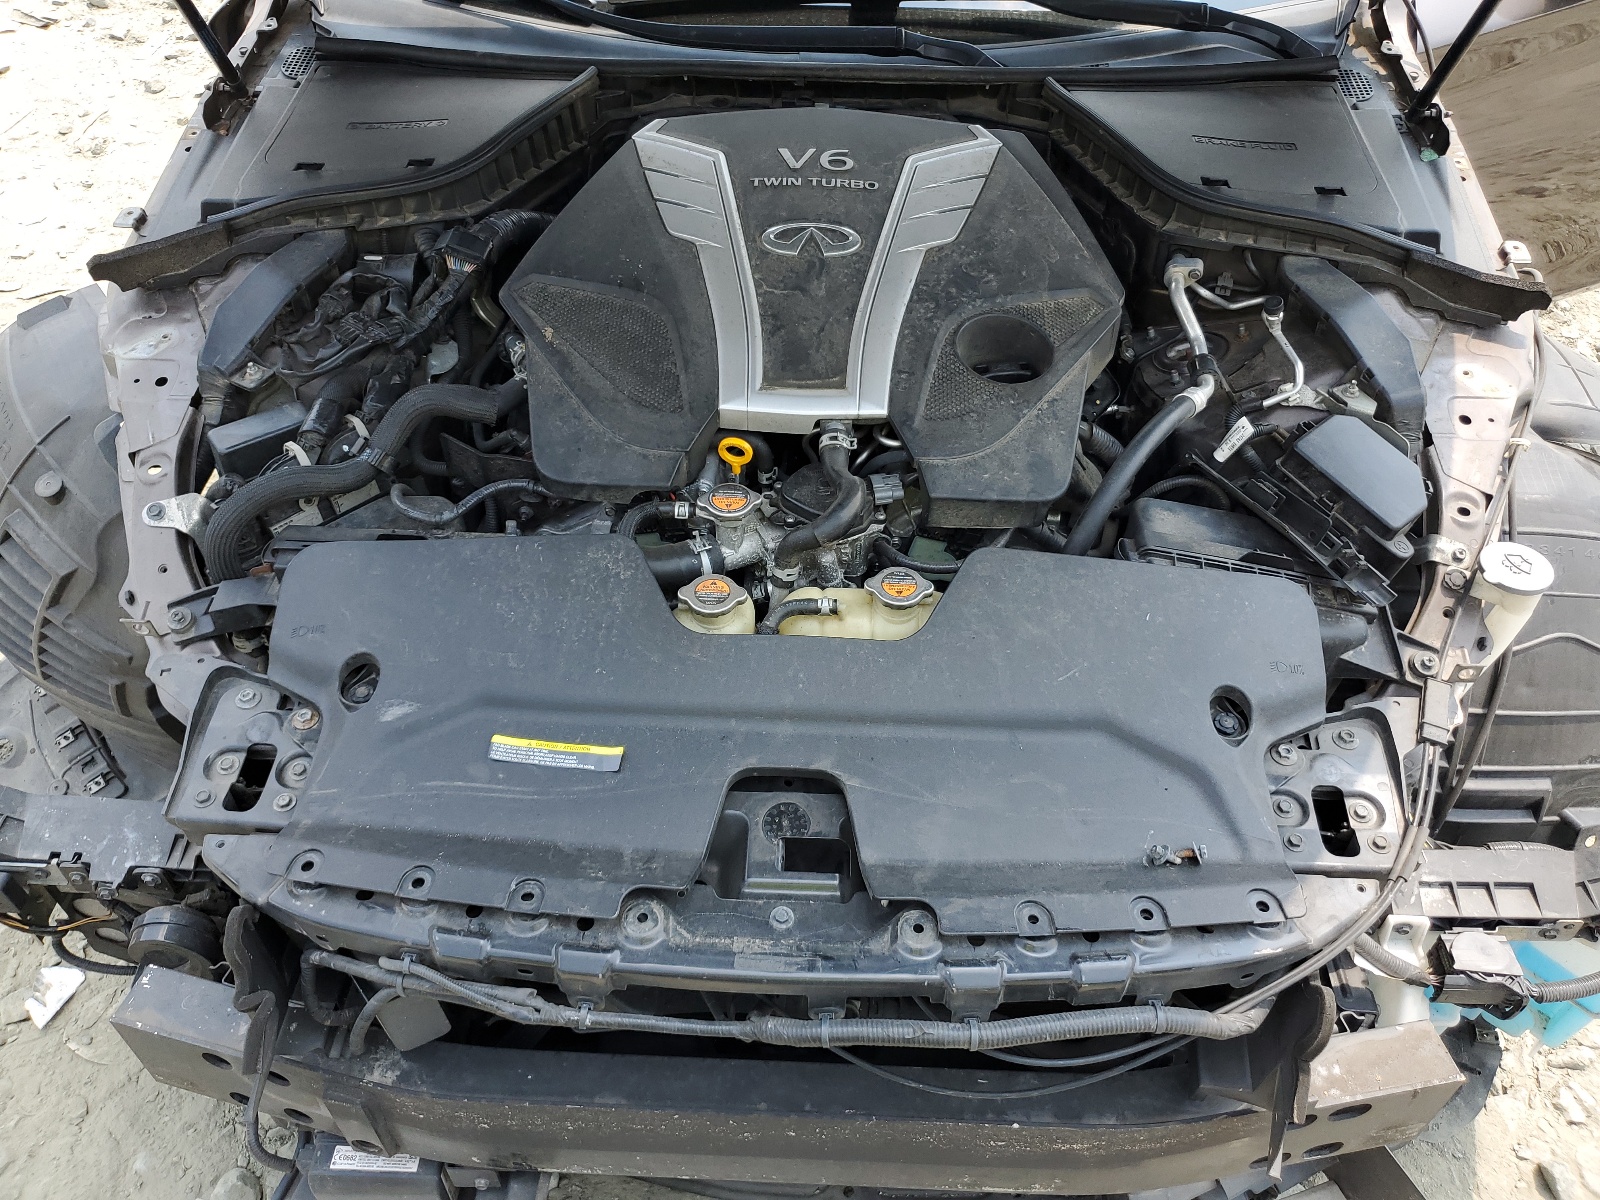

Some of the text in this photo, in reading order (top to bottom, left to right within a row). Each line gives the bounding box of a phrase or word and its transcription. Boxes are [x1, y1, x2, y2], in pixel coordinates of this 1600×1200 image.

[1193, 137, 1295, 151] BRAKE FLUID
[777, 148, 854, 171] V6
[750, 177, 879, 190] TWIN TURBO
